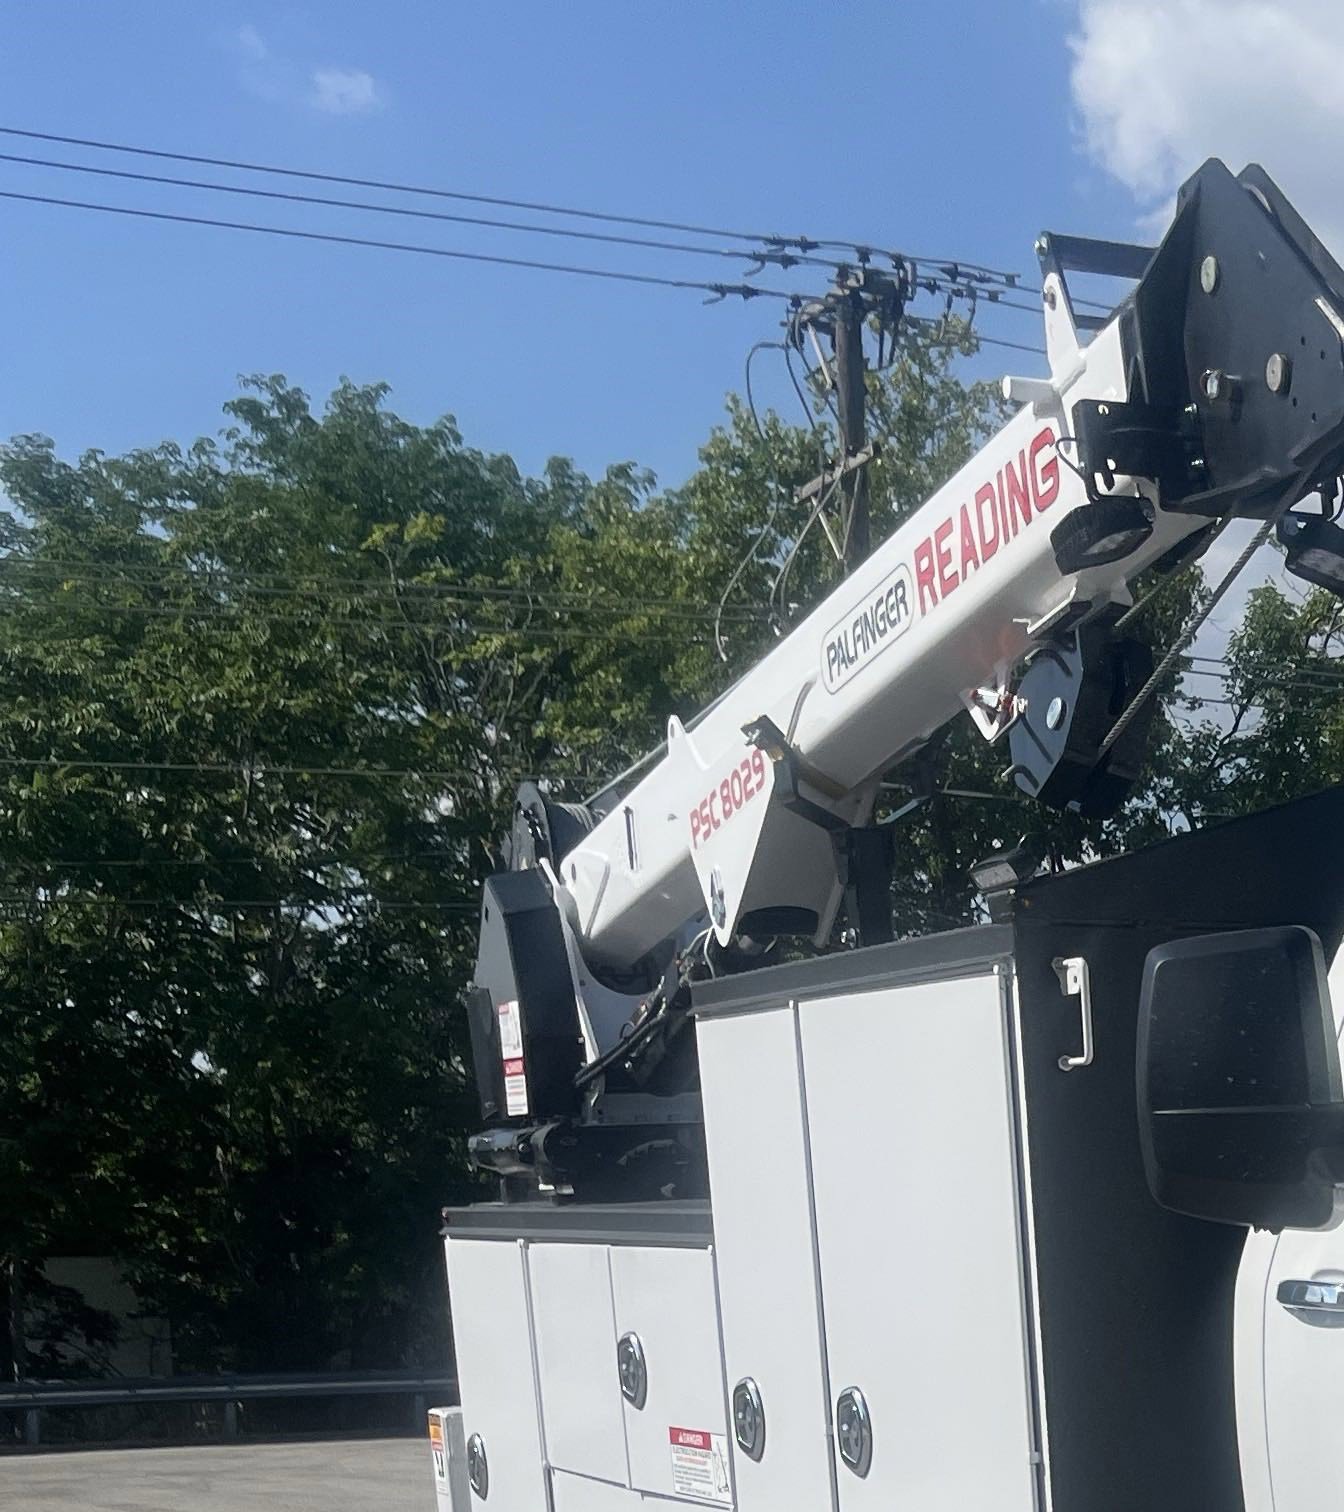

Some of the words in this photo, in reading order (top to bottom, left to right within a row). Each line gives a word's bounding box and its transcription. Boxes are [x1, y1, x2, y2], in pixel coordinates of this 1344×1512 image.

[913, 426, 1062, 617] READING
[826, 578, 910, 683] PALFINGER
[688, 790, 721, 850] PSC
[721, 749, 766, 821] 8029
